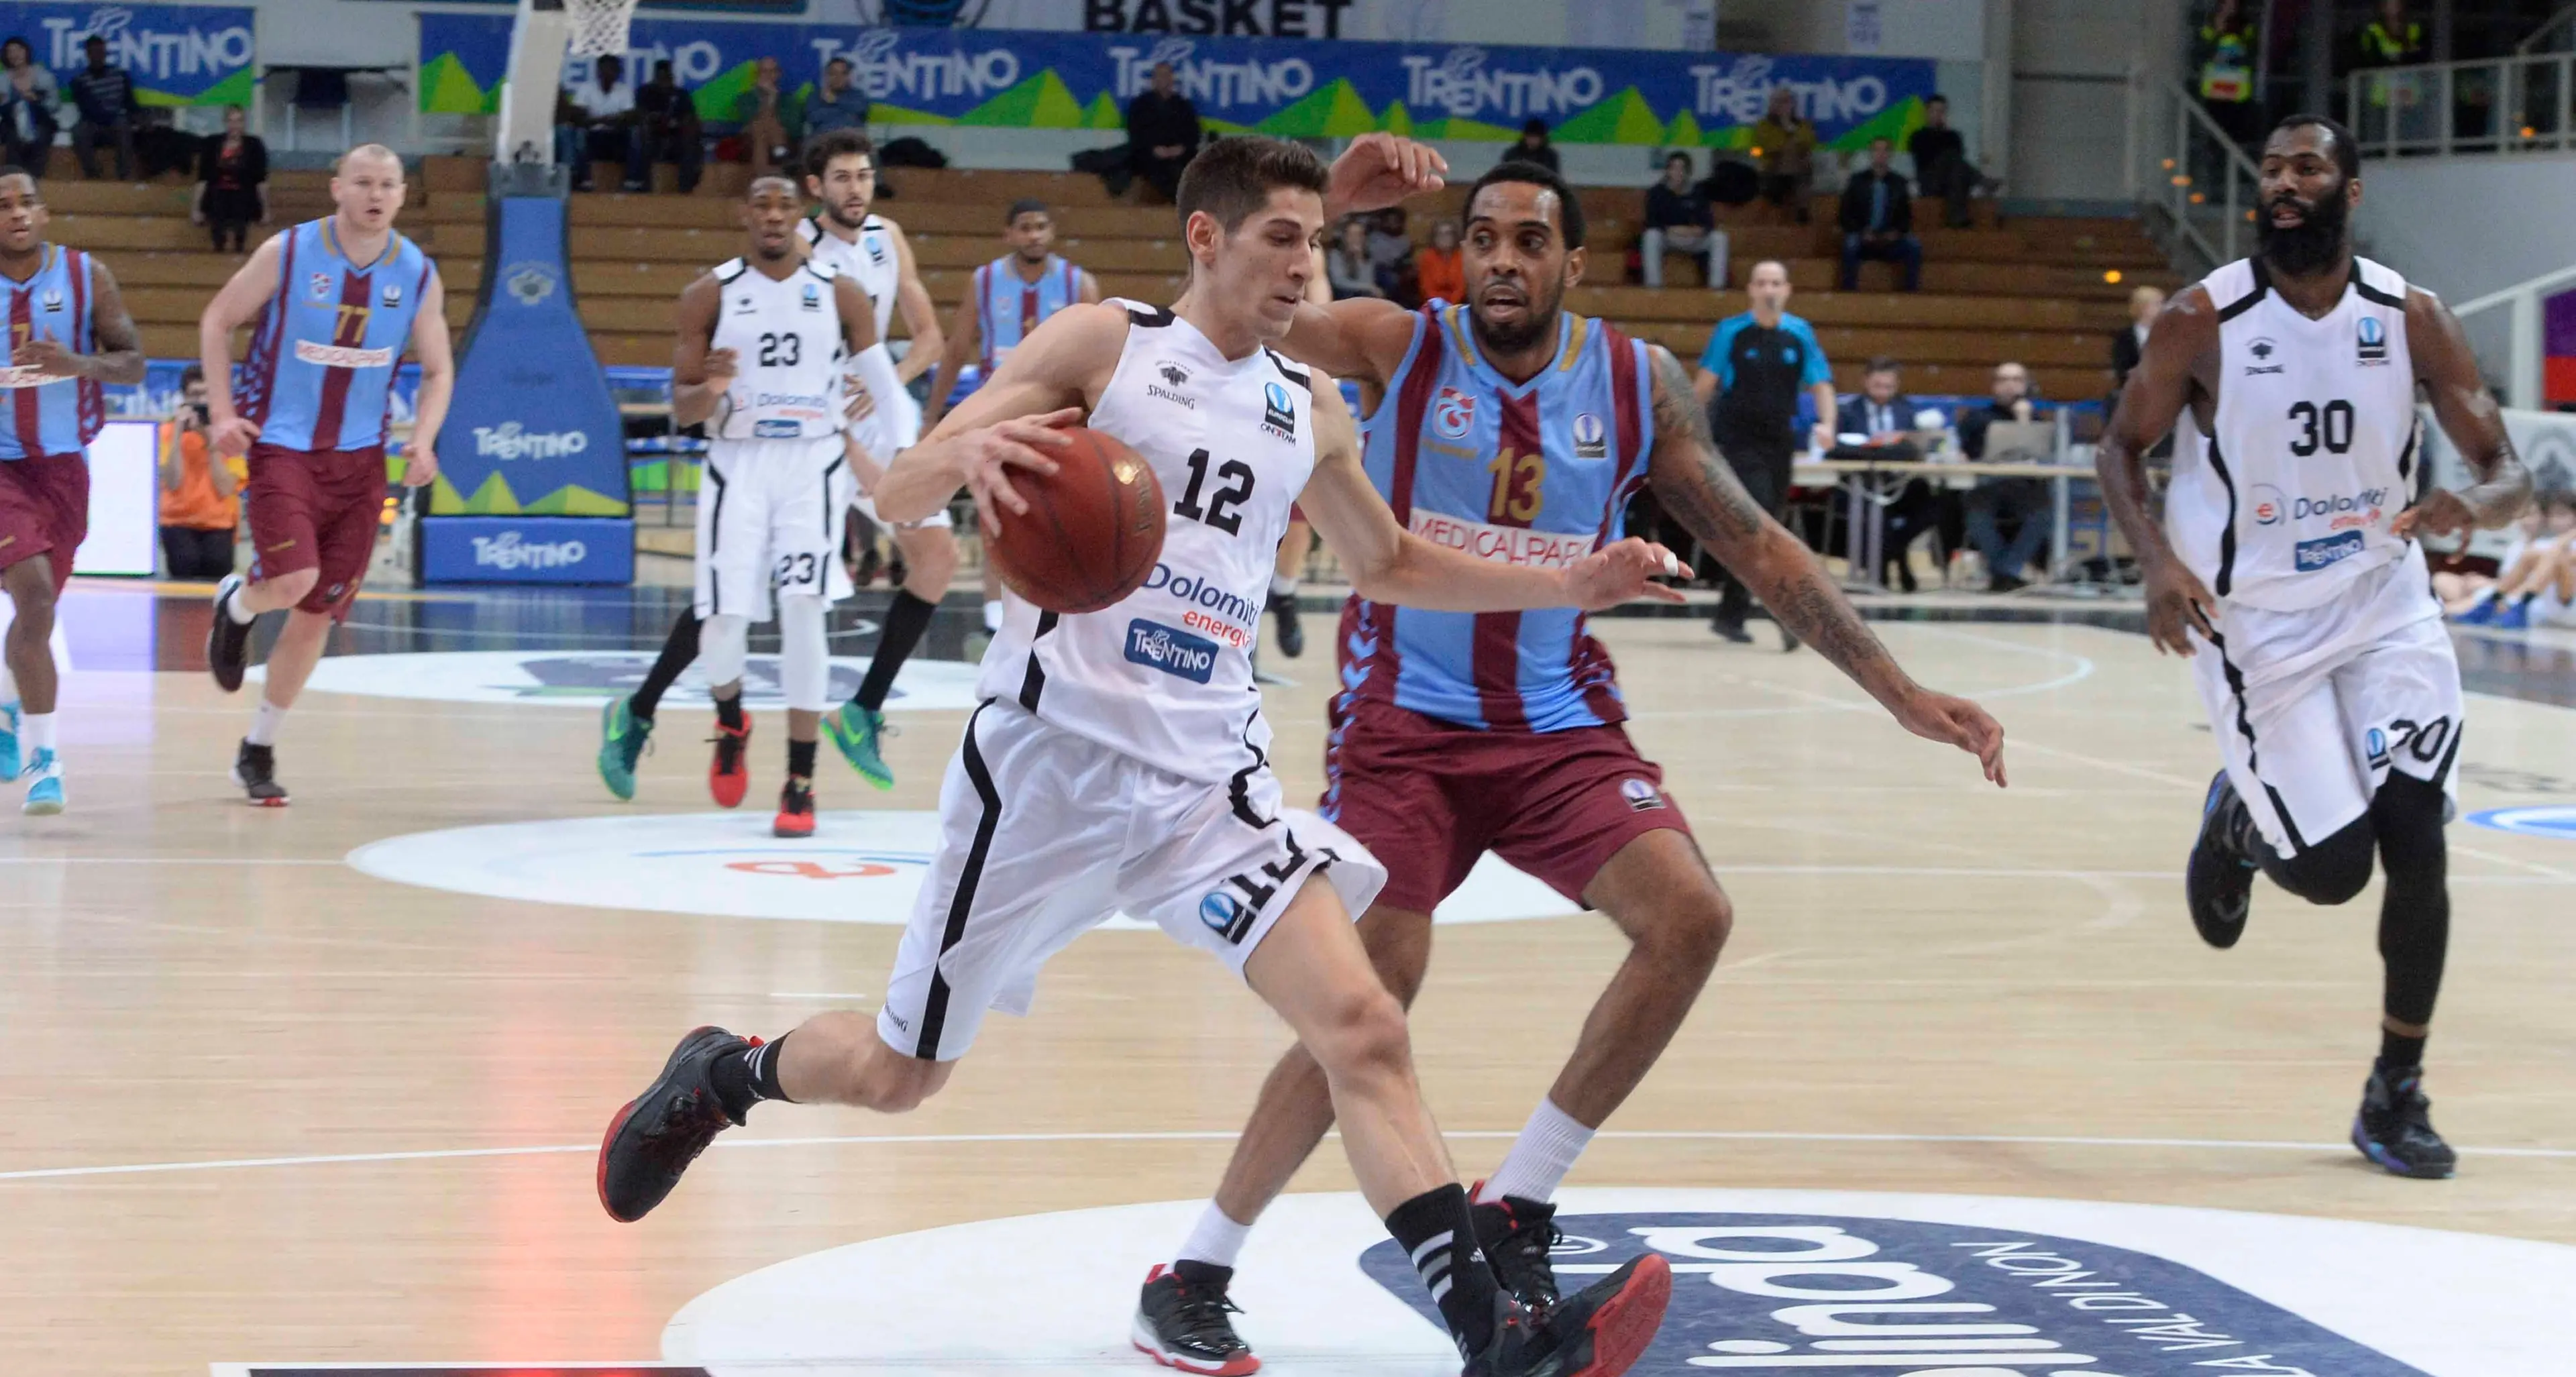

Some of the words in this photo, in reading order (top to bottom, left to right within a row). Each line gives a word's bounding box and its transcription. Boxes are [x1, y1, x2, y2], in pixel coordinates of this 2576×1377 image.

[1084, 0, 1351, 38] BASKET
[1401, 56, 1603, 117] TRENTINO
[335, 305, 374, 343] 77
[759, 333, 800, 367] 23
[1146, 384, 1195, 410] SPALDING
[472, 425, 588, 460] TRENTINO
[2288, 399, 2355, 457] 30
[1173, 448, 1255, 537] 12
[1487, 447, 1546, 522] 13
[472, 536, 587, 570] TRENTINO
[771, 552, 816, 586] 23
[1141, 562, 1260, 627] Dolomiti
[1134, 628, 1210, 672] TRENTINO
